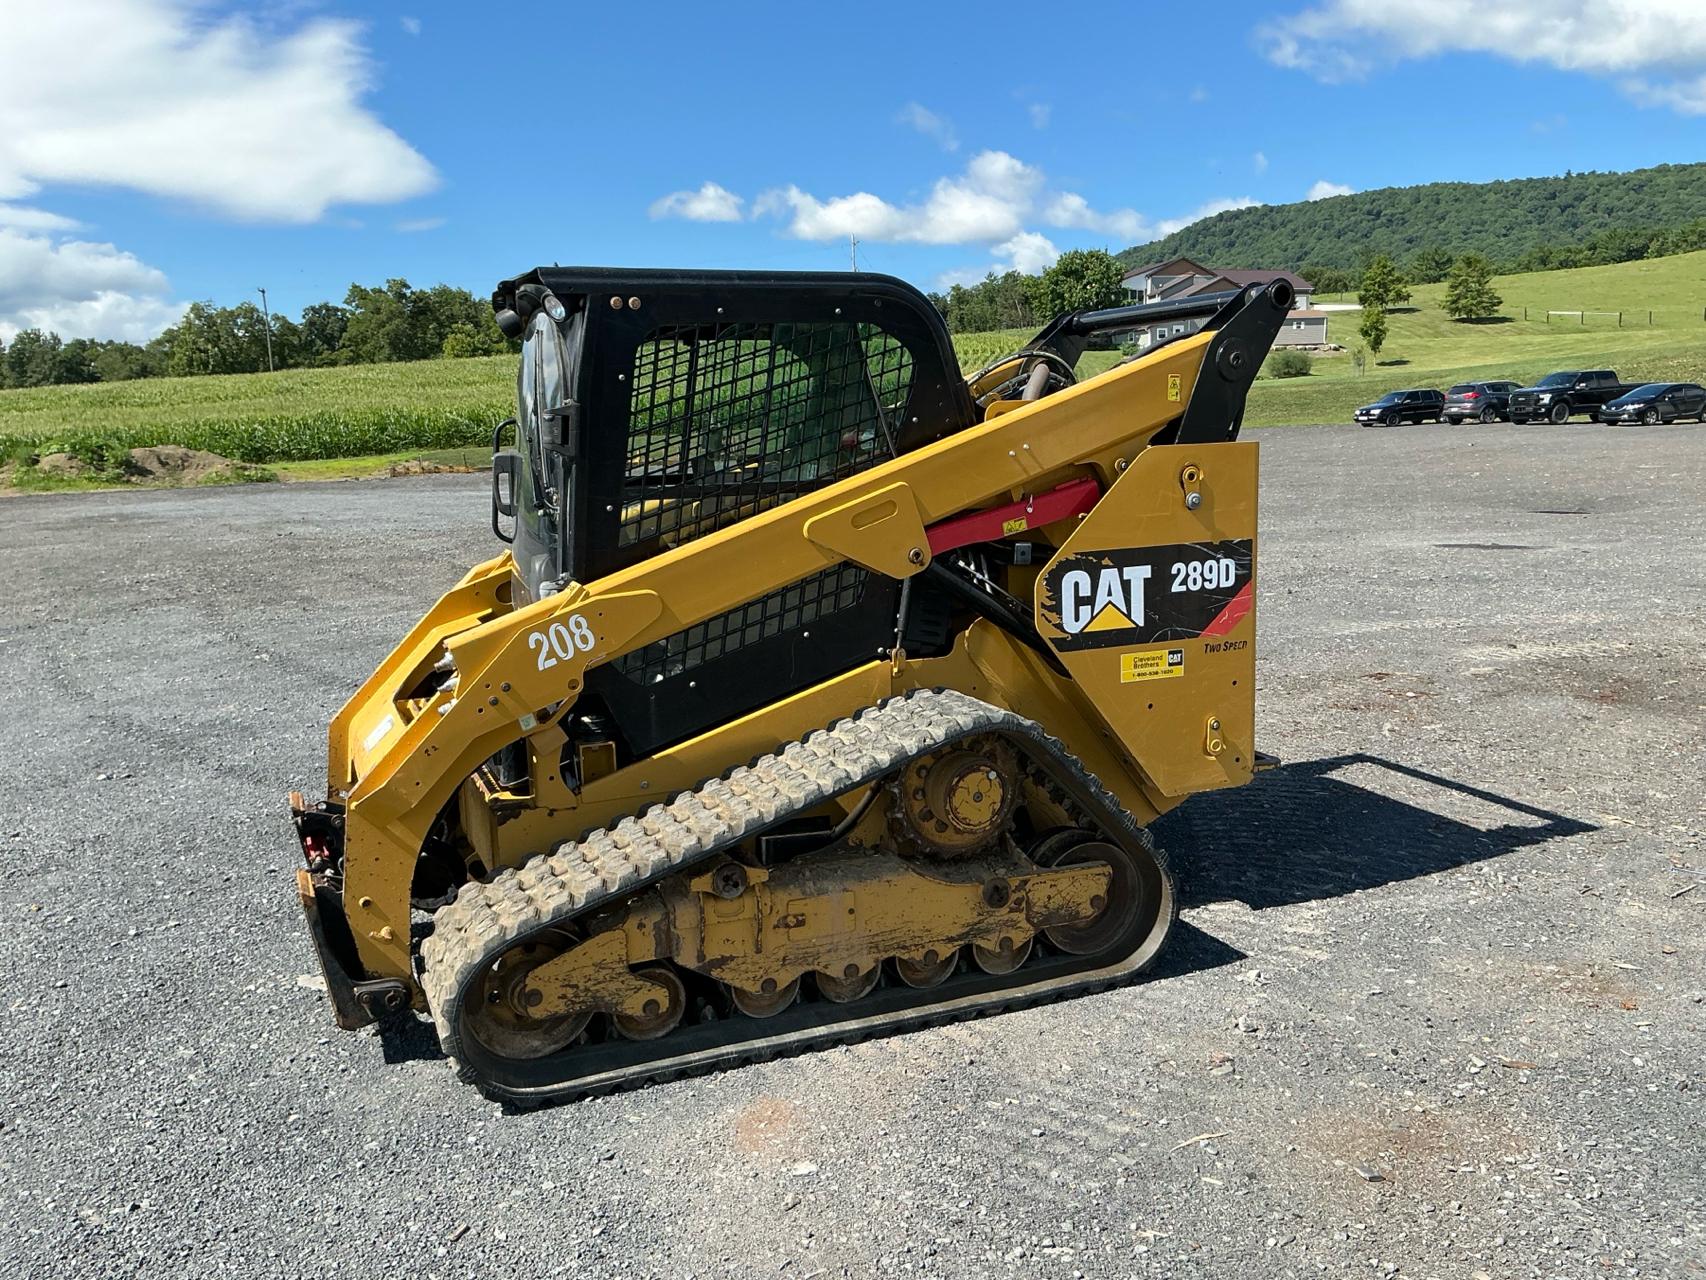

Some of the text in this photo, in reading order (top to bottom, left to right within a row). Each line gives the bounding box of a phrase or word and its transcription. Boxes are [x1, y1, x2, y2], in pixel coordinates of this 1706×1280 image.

[1170, 558, 1236, 593] 289D
[1061, 565, 1151, 634] CAT
[528, 614, 595, 671] 208
[1133, 655, 1163, 664] Cleveland
[1168, 653, 1182, 663] CAT
